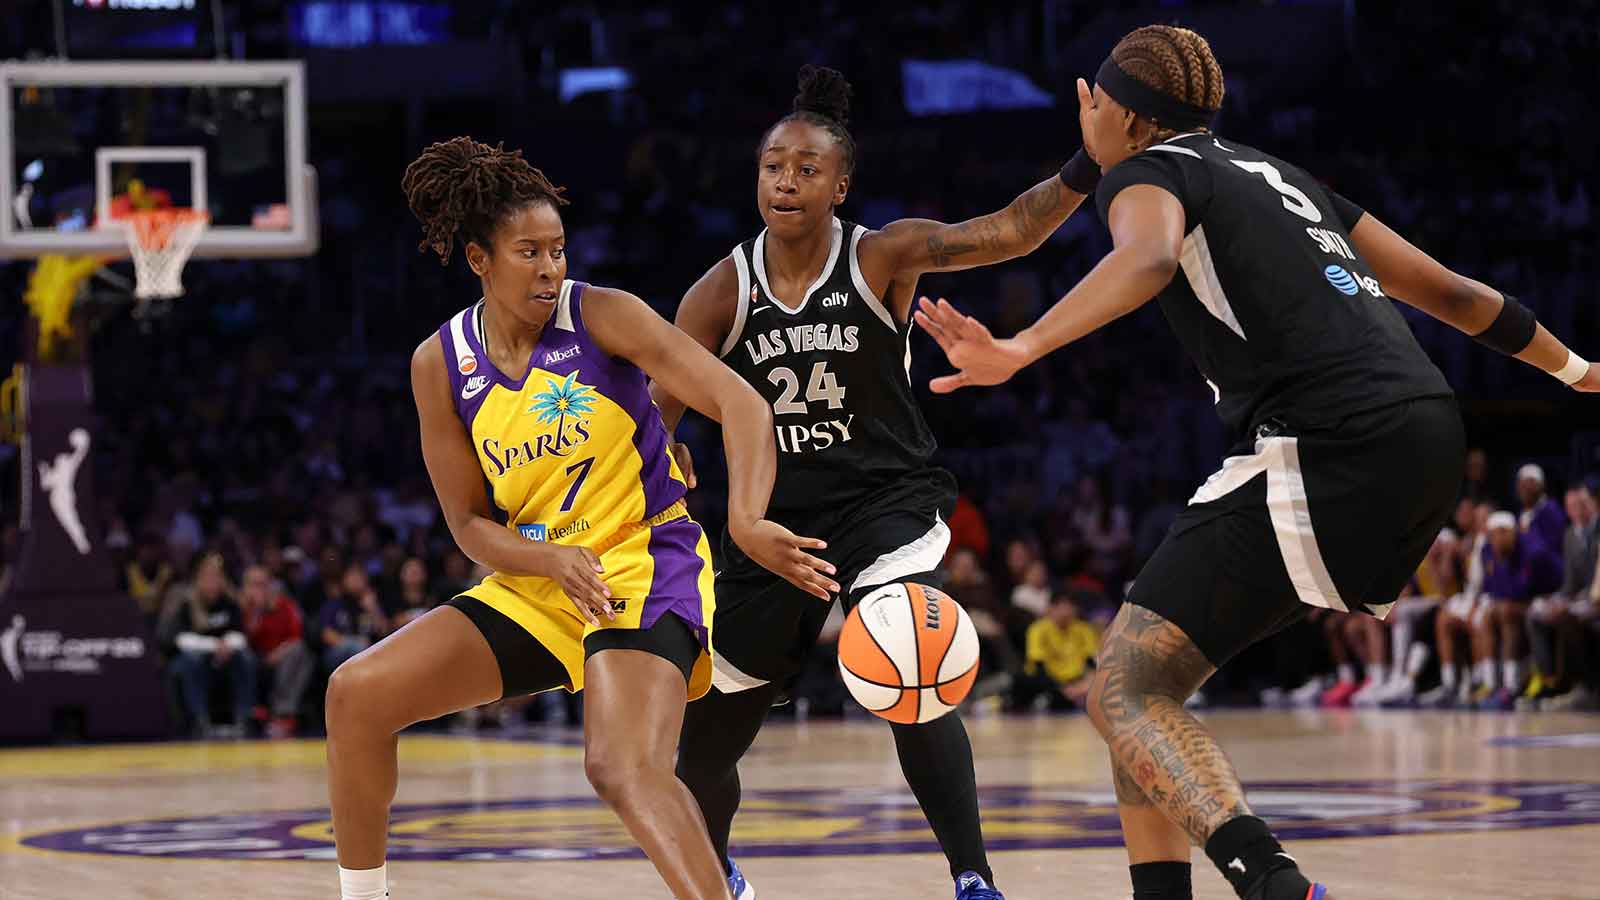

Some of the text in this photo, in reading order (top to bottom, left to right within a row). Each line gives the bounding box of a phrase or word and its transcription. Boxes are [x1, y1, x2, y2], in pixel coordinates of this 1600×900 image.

[1229, 159, 1322, 223] 3
[822, 291, 849, 308] ally
[544, 344, 582, 366] Albert
[745, 323, 859, 366] LAS VEGAS
[466, 375, 487, 391] NIKE
[767, 361, 846, 415] 24
[775, 413, 855, 453] IPSY
[559, 456, 596, 513] 7
[521, 518, 591, 542] UCLA Health
